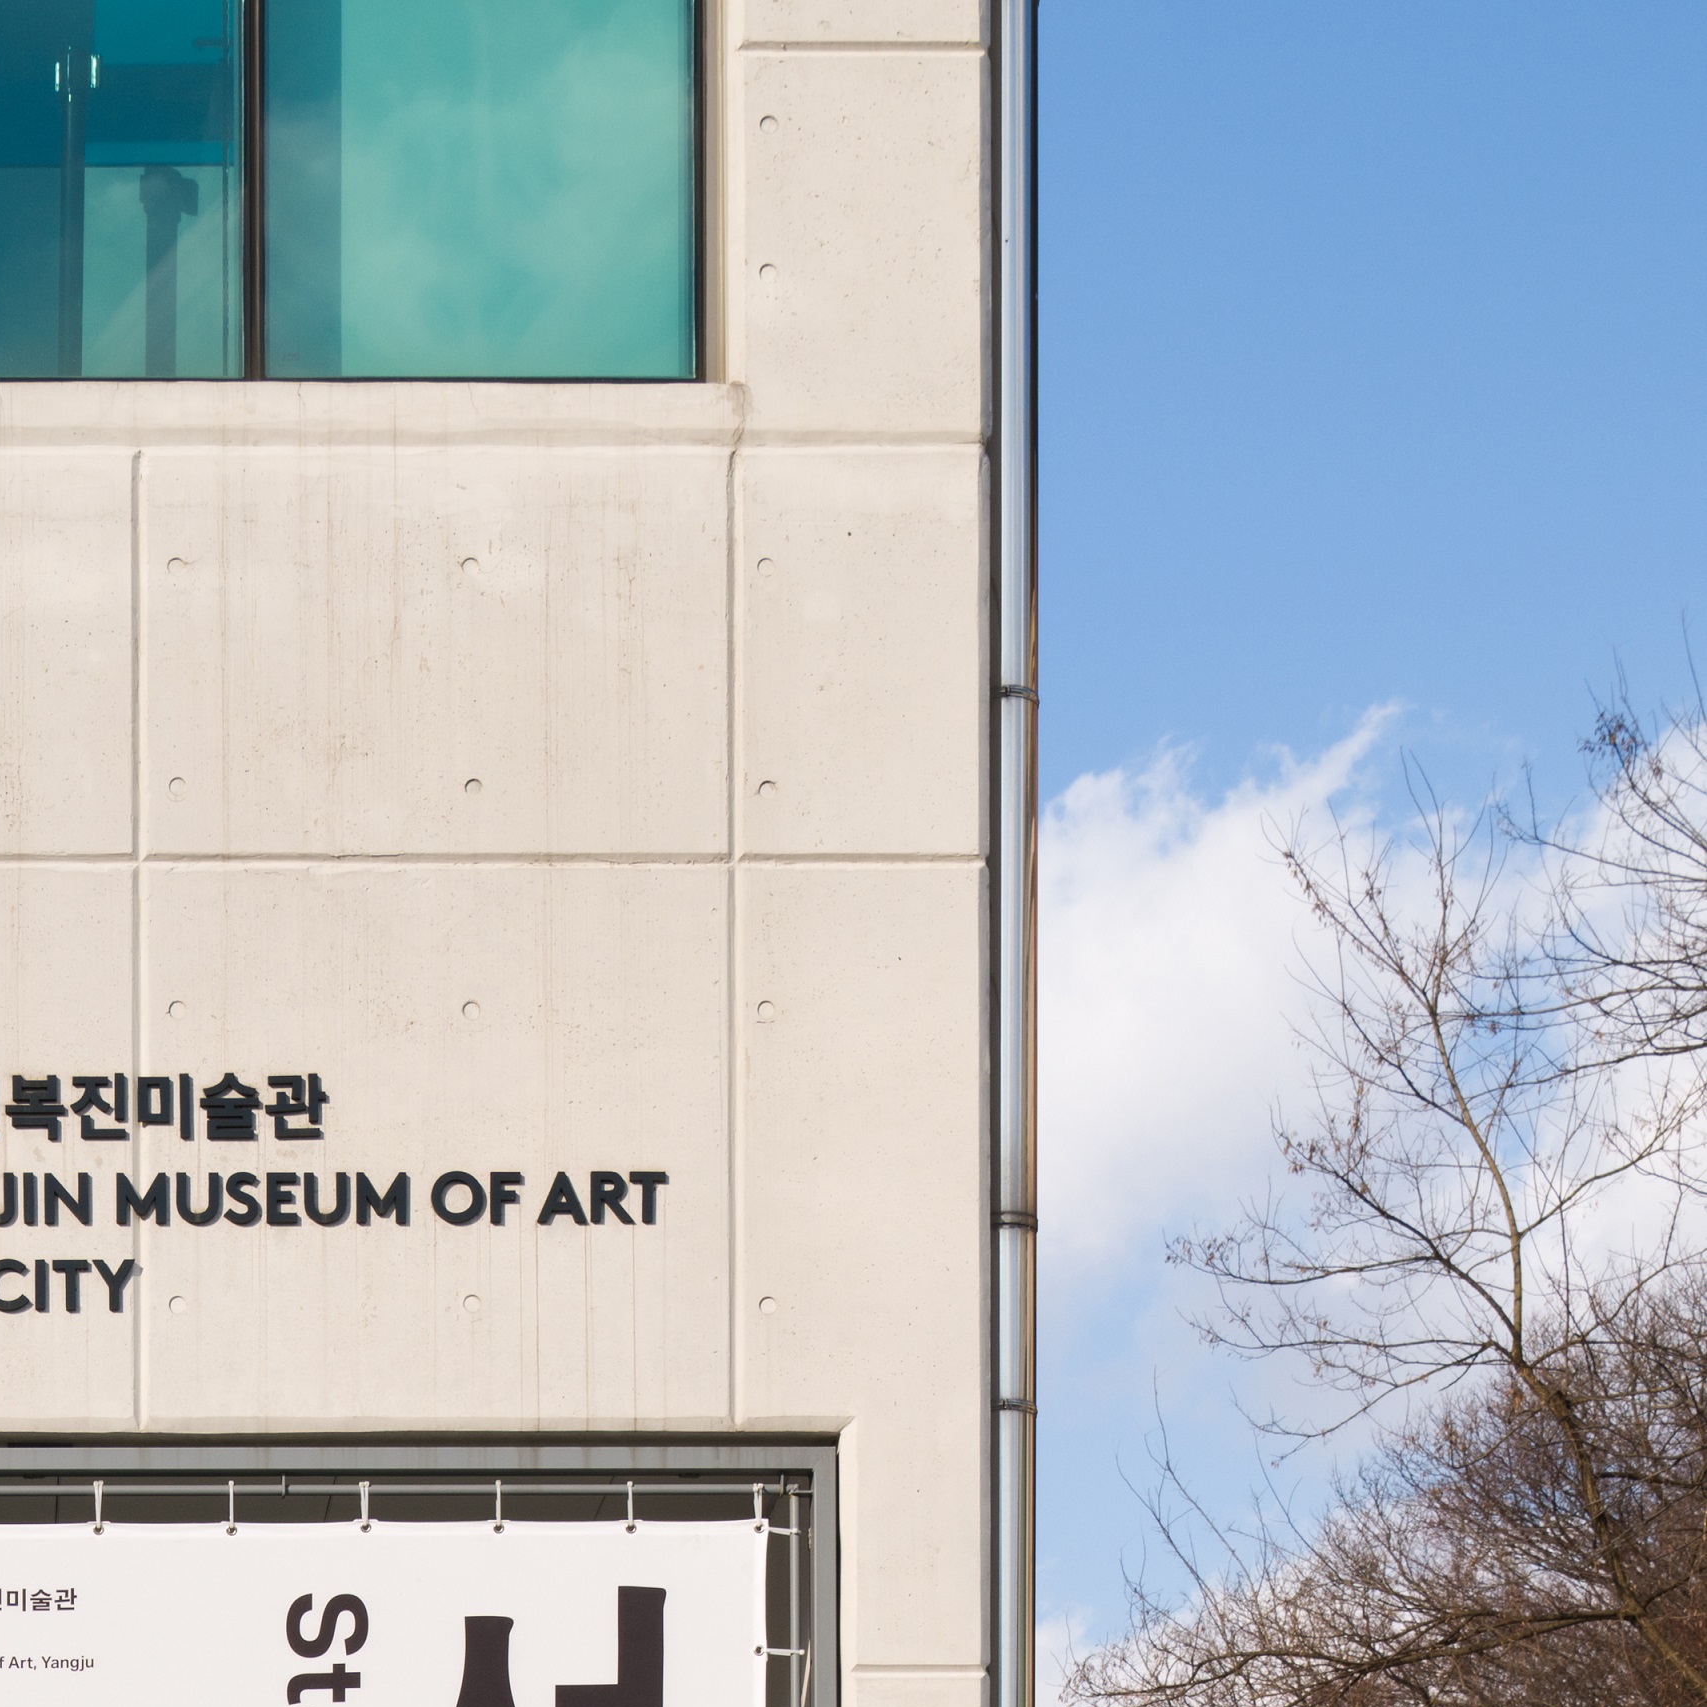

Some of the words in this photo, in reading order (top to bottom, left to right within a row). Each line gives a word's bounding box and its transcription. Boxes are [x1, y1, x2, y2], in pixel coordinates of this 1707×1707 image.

[117, 1172, 410, 1226] MUSEUM
[431, 1171, 523, 1226] OF
[537, 1171, 668, 1225] ART
[8, 1656, 37, 1671] Art,
[41, 1655, 94, 1672] Yangju
